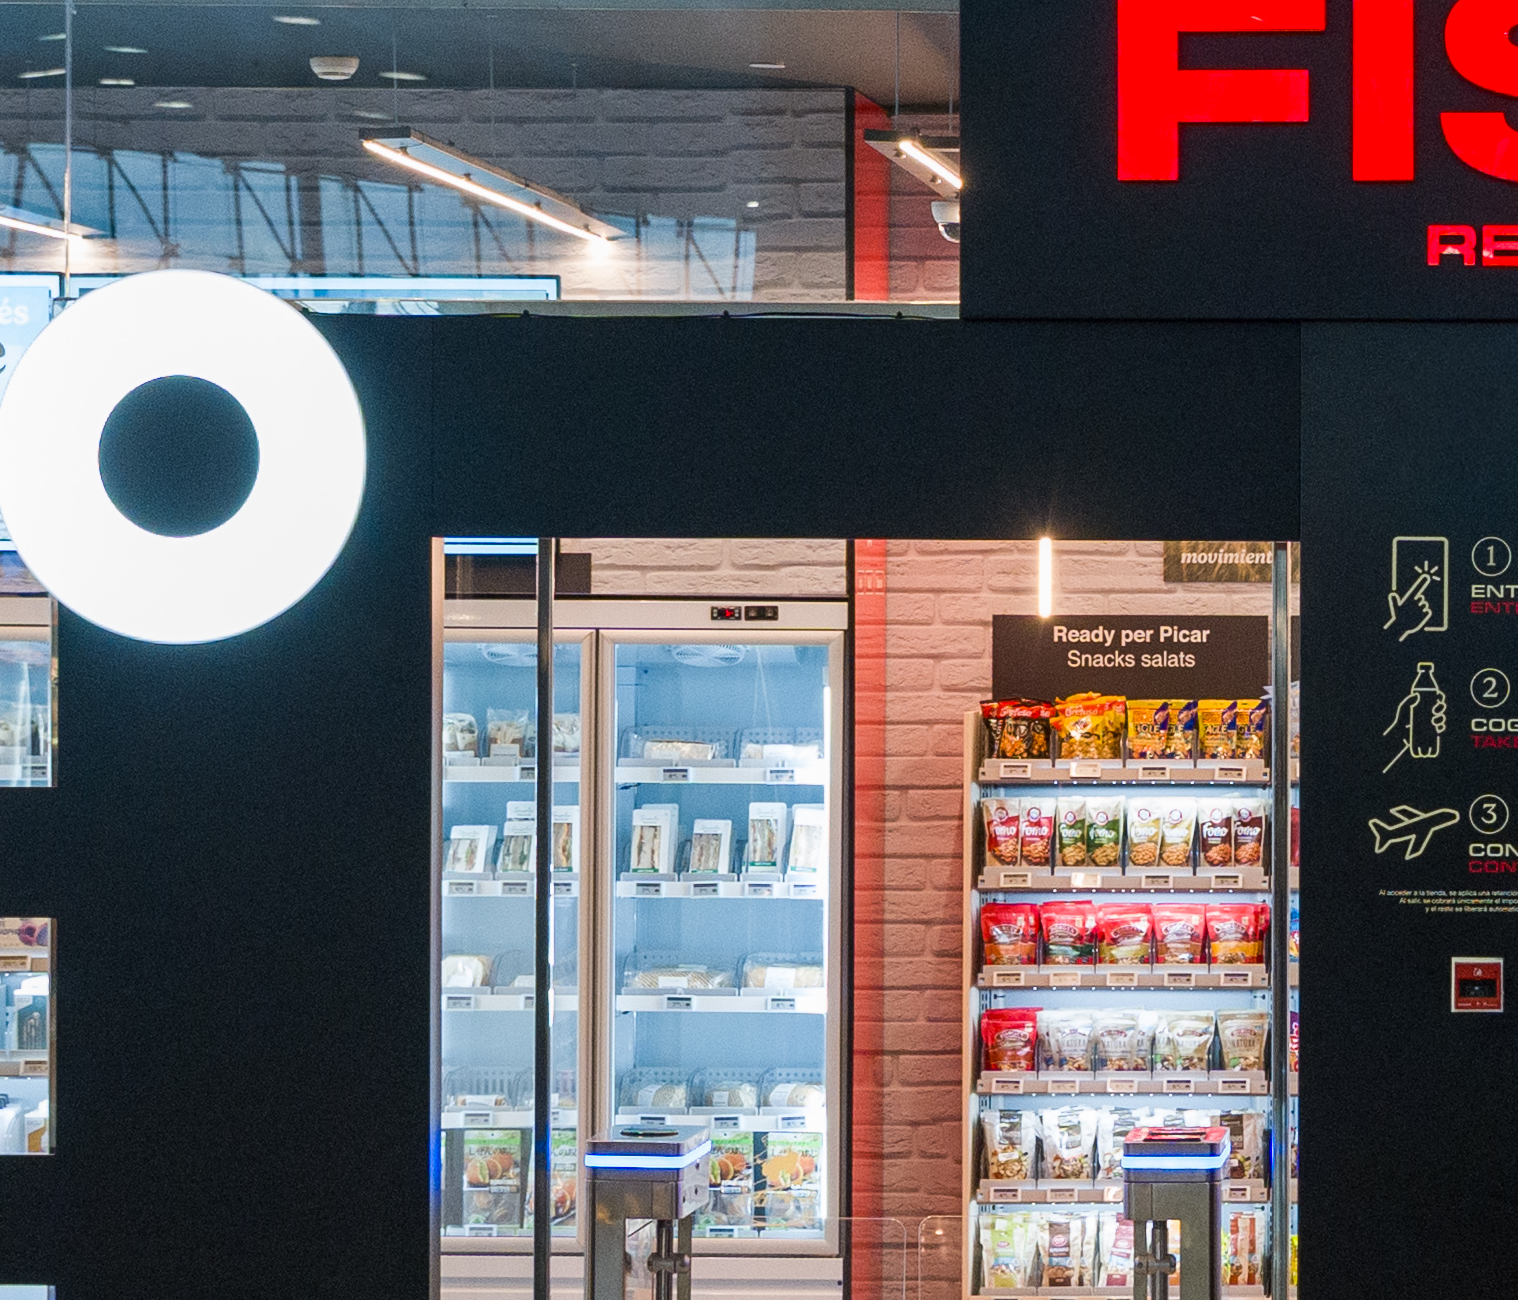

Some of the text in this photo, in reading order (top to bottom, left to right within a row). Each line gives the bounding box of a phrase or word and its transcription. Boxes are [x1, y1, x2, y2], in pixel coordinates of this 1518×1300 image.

[1053, 625, 1211, 647] Ready per Picar
[1067, 649, 1196, 668] Snacks salats
